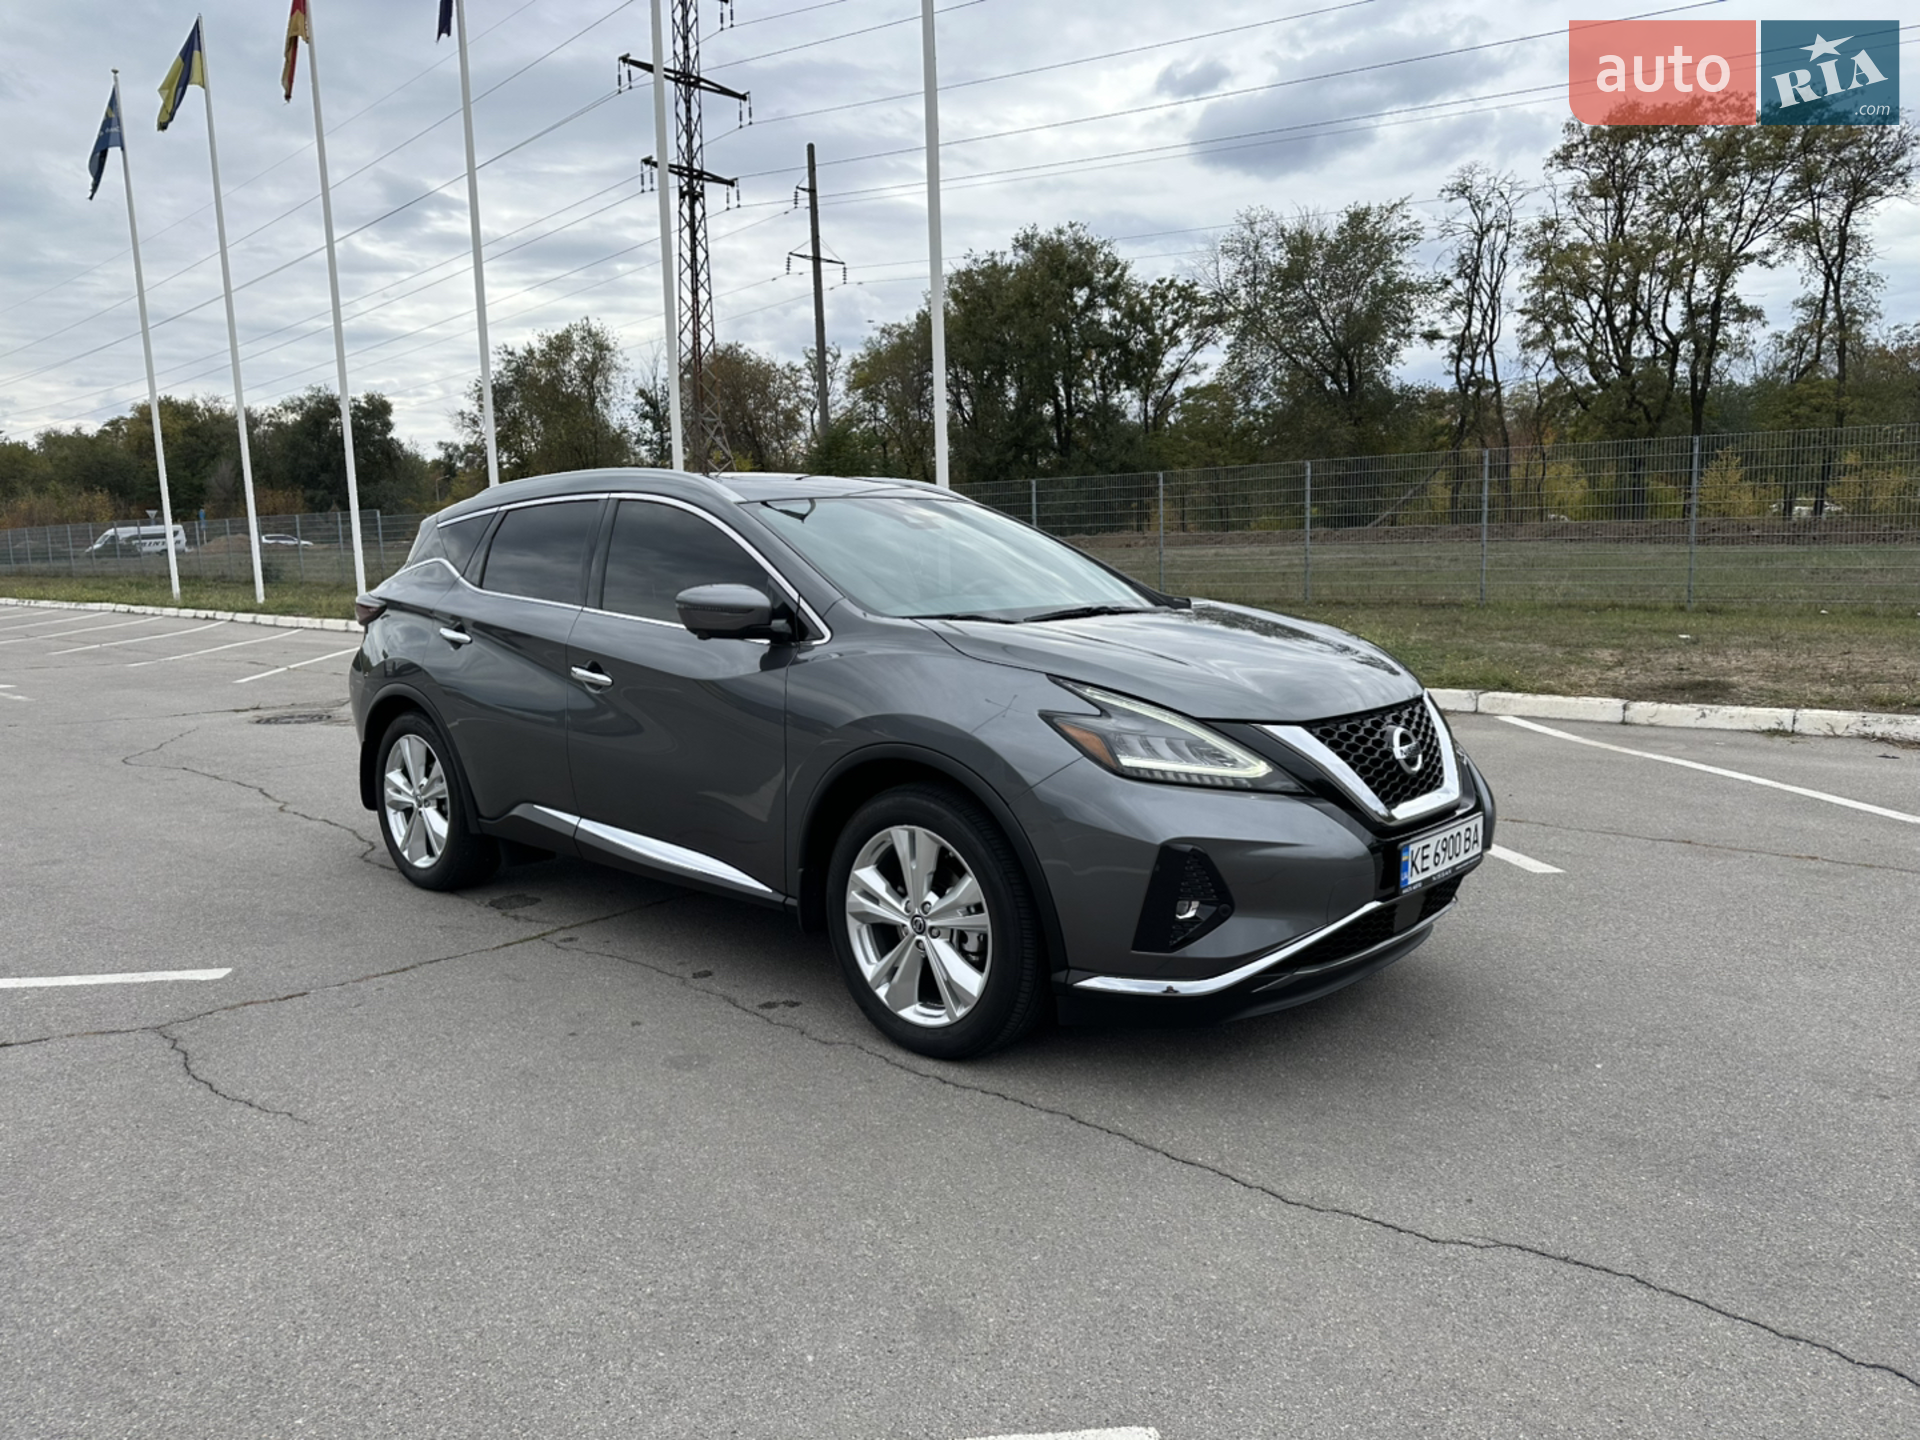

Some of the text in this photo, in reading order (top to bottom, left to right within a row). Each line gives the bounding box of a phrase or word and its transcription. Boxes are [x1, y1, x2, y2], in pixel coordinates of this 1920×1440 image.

[1410, 844, 1430, 877] KE
[1433, 831, 1462, 867] 6900
[1463, 824, 1479, 854] BA
